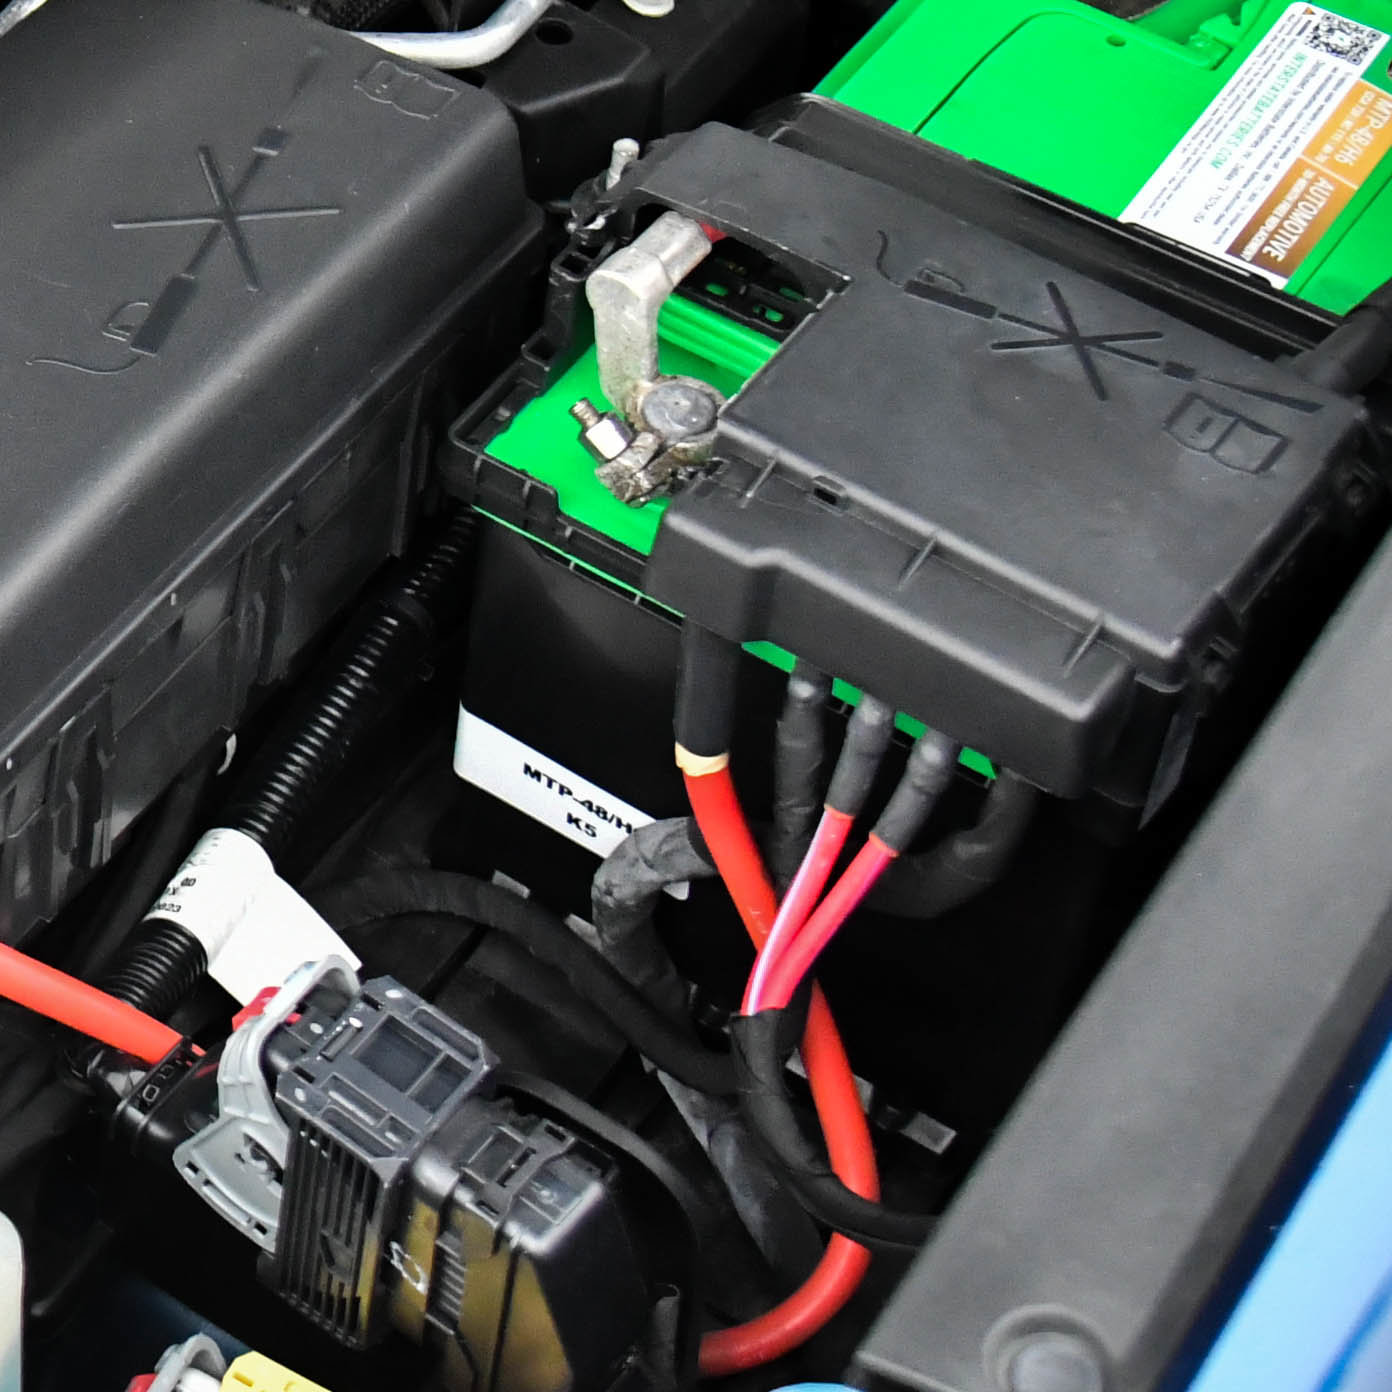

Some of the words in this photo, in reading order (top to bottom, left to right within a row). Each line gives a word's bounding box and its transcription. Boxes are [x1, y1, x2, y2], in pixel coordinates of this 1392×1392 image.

[1263, 177, 1335, 262] AUTOMOTIVE
[523, 762, 633, 835] MTP-48/H
[566, 812, 597, 838] K5
